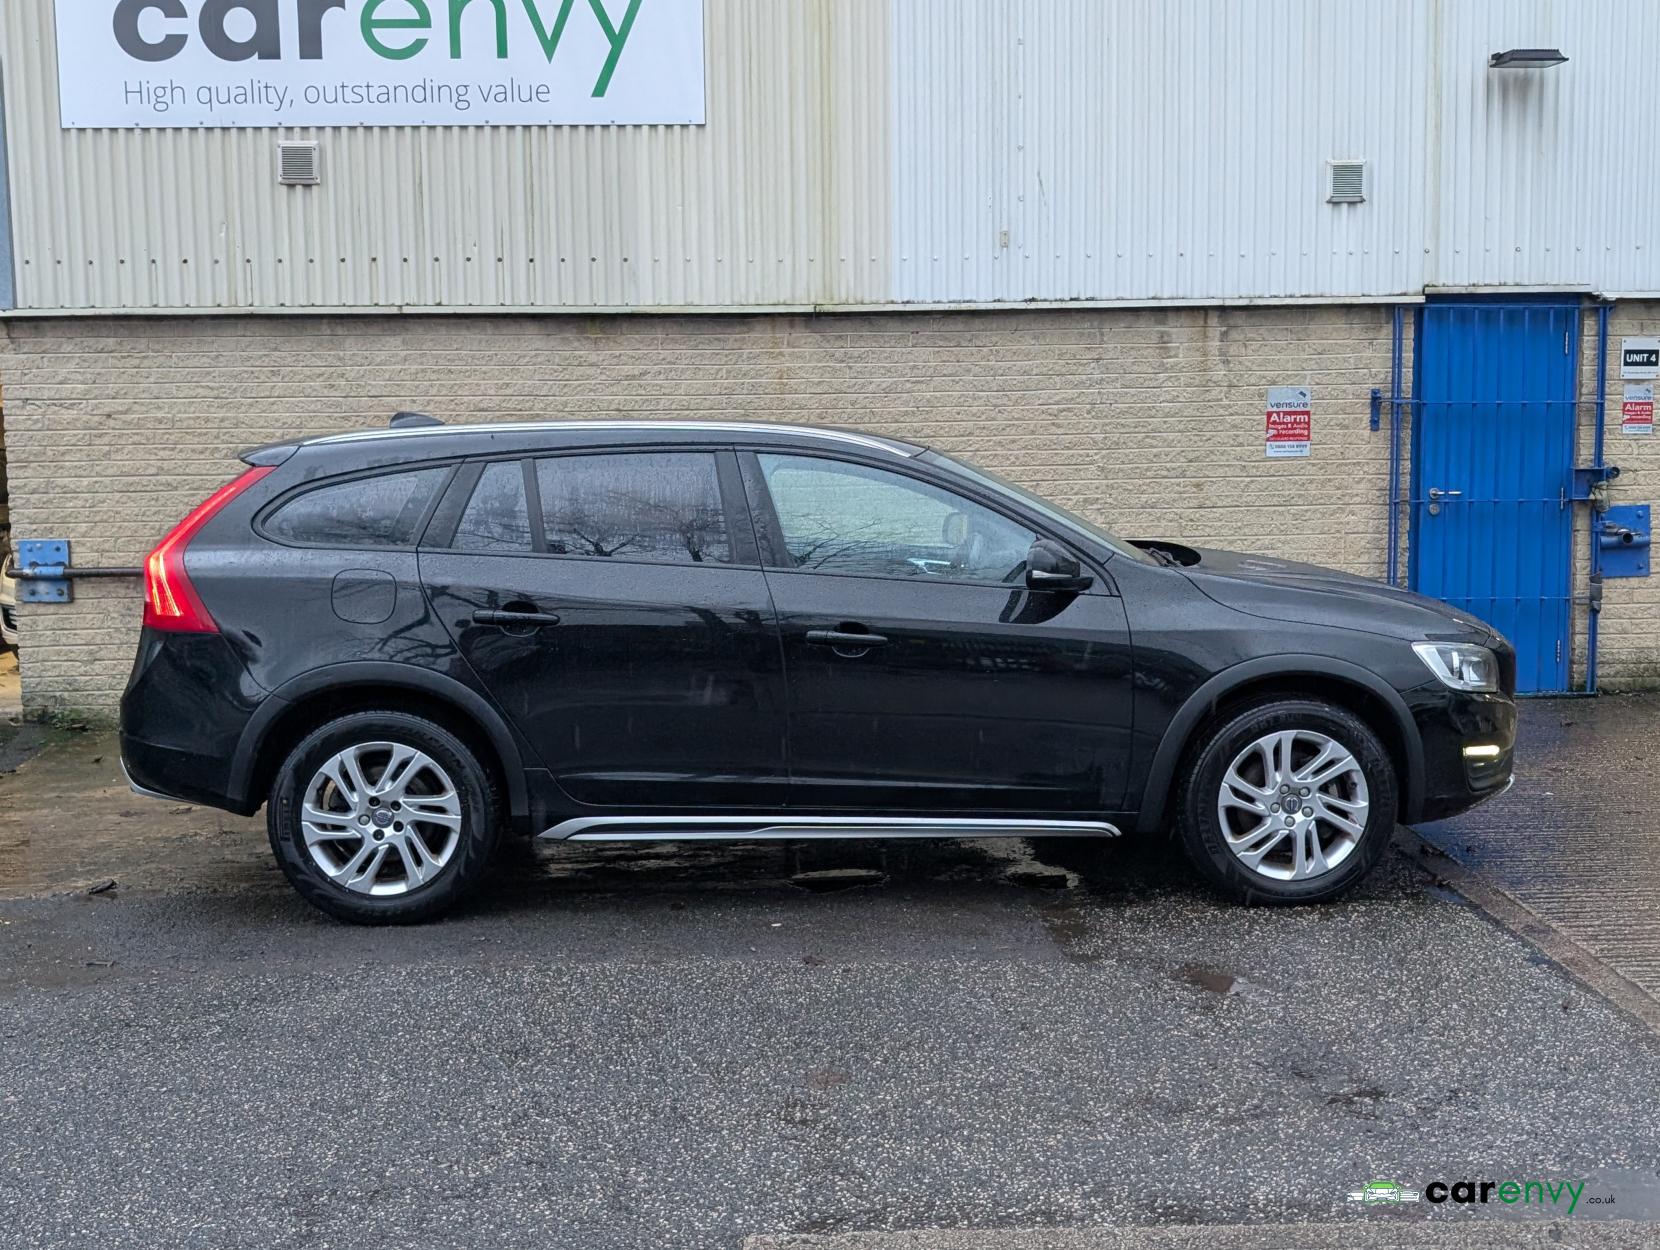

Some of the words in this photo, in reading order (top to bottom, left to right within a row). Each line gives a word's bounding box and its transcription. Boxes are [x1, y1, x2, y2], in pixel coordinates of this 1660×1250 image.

[112, 0, 642, 98] carenvy
[124, 79, 186, 112] High
[196, 79, 294, 111] quality,
[304, 78, 471, 111] outstanding
[478, 77, 550, 103] value
[1626, 353, 1649, 362] UNIT
[1650, 353, 1656, 362] 4
[1625, 403, 1651, 411] Alarm
[1270, 412, 1308, 422] Alarm
